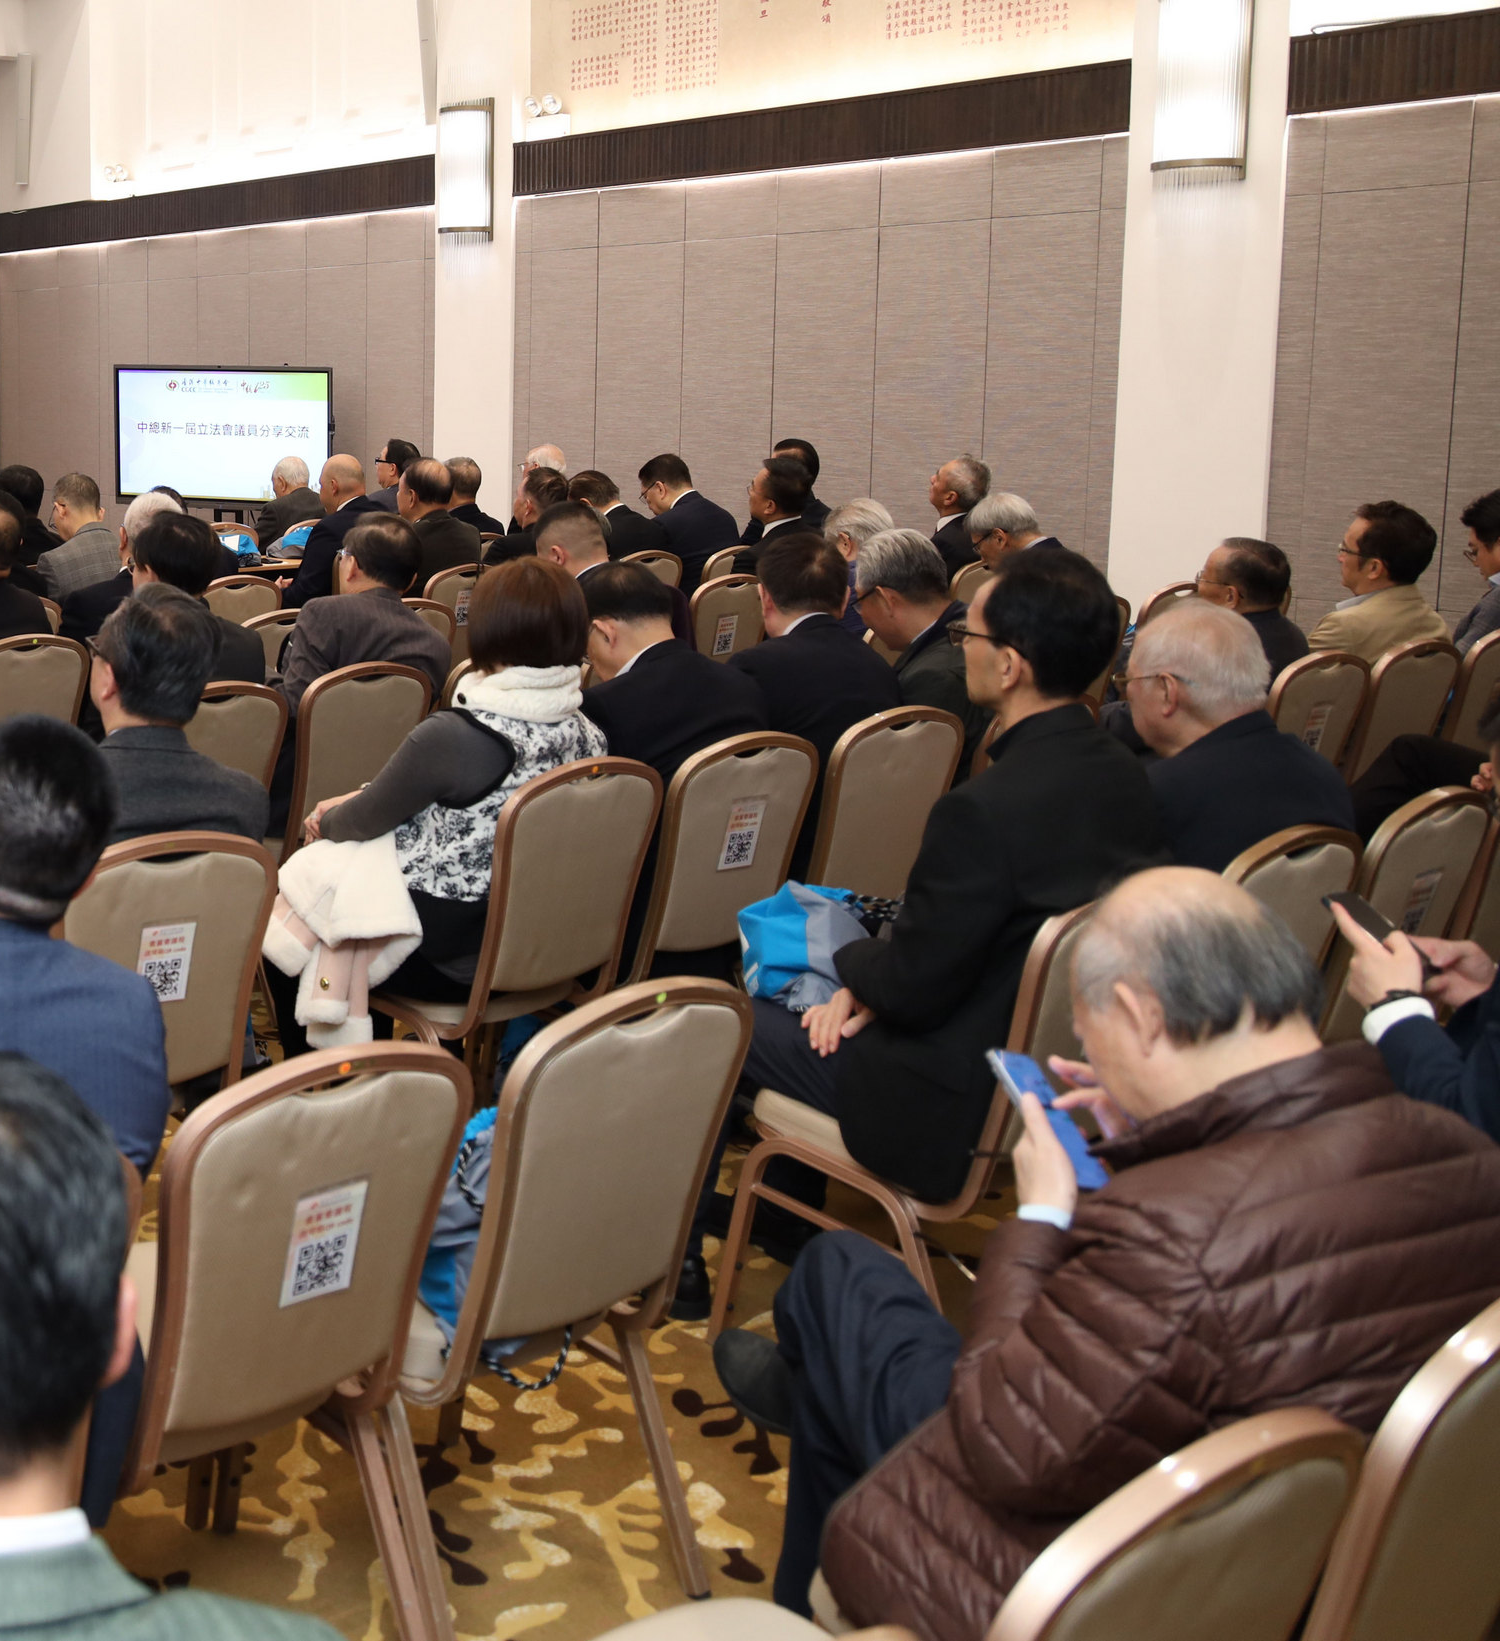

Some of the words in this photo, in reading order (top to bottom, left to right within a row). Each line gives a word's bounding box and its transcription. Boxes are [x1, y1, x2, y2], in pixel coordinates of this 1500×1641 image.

[137, 422, 310, 439] 中總新一屆立法會議員分享交流
